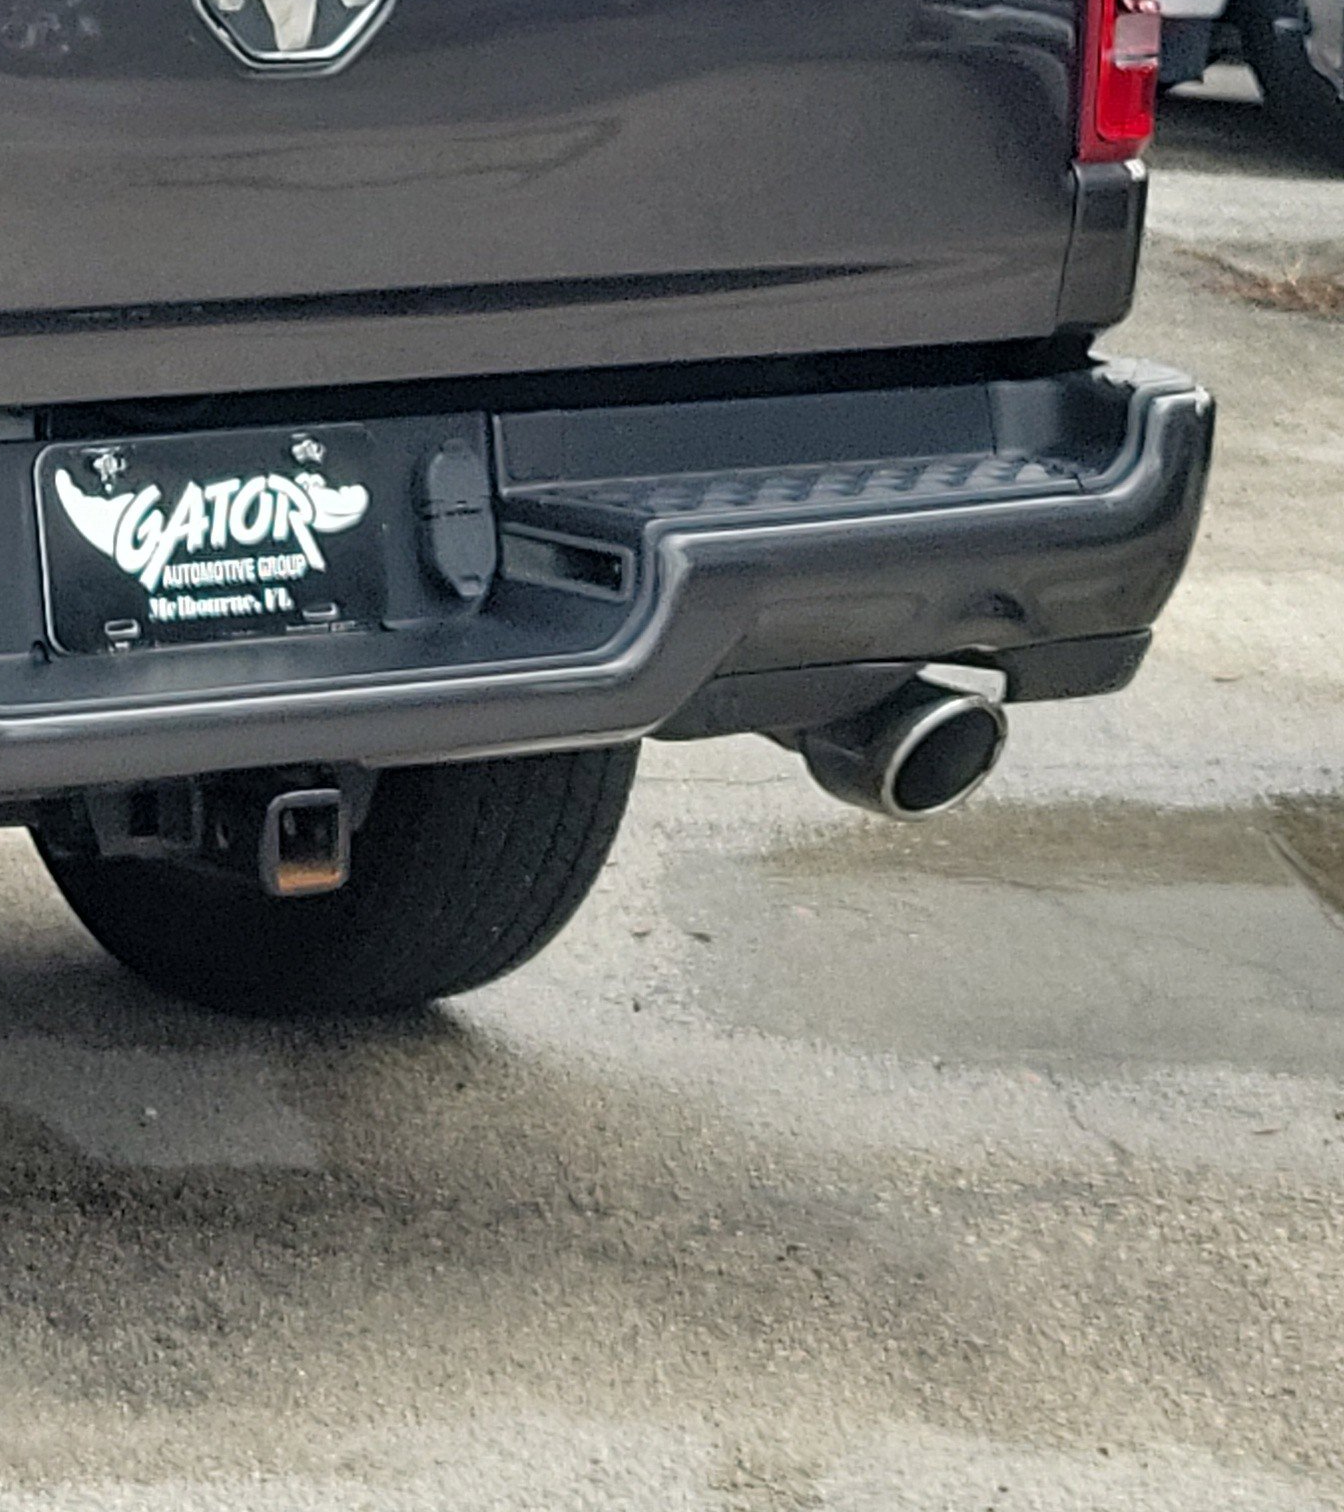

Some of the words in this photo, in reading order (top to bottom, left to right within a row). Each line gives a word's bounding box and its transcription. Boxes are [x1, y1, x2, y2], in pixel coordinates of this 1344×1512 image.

[114, 474, 326, 592] GATOR
[163, 558, 256, 588] AUTOMOTIVE
[258, 553, 307, 580] GROUP
